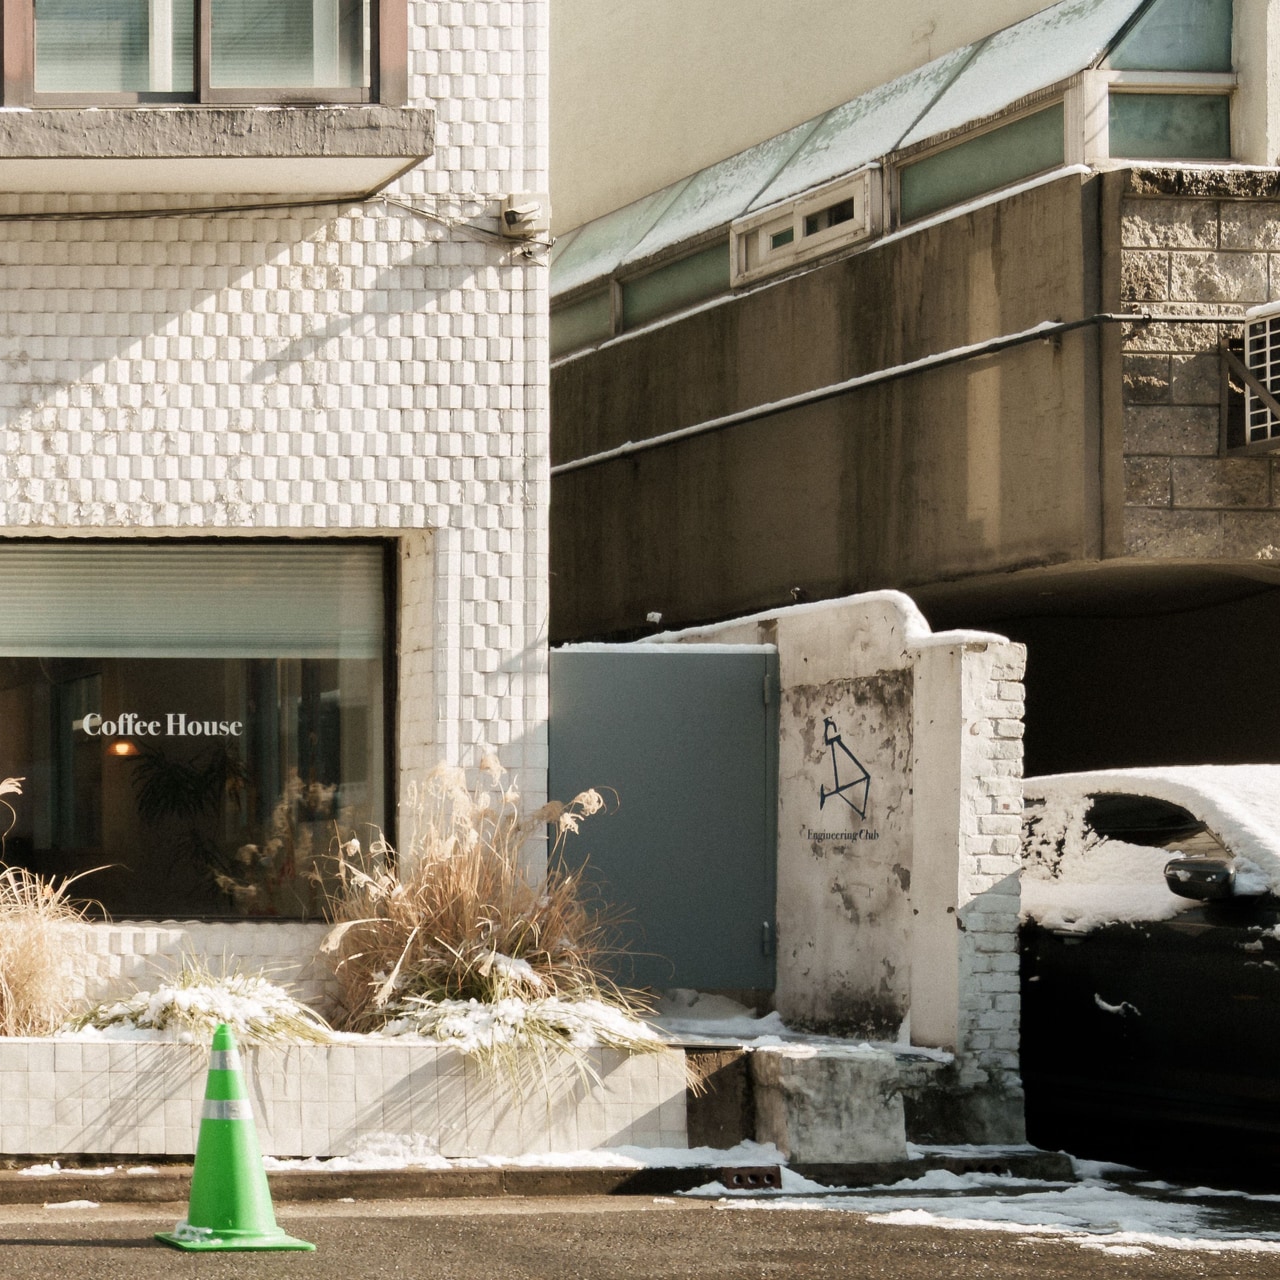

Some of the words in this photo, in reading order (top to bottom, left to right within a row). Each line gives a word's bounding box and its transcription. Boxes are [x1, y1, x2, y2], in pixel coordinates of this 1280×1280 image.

[82, 712, 161, 736] Coffee
[164, 713, 243, 736] House
[807, 828, 858, 843] Engineering
[858, 828, 880, 841] Club
